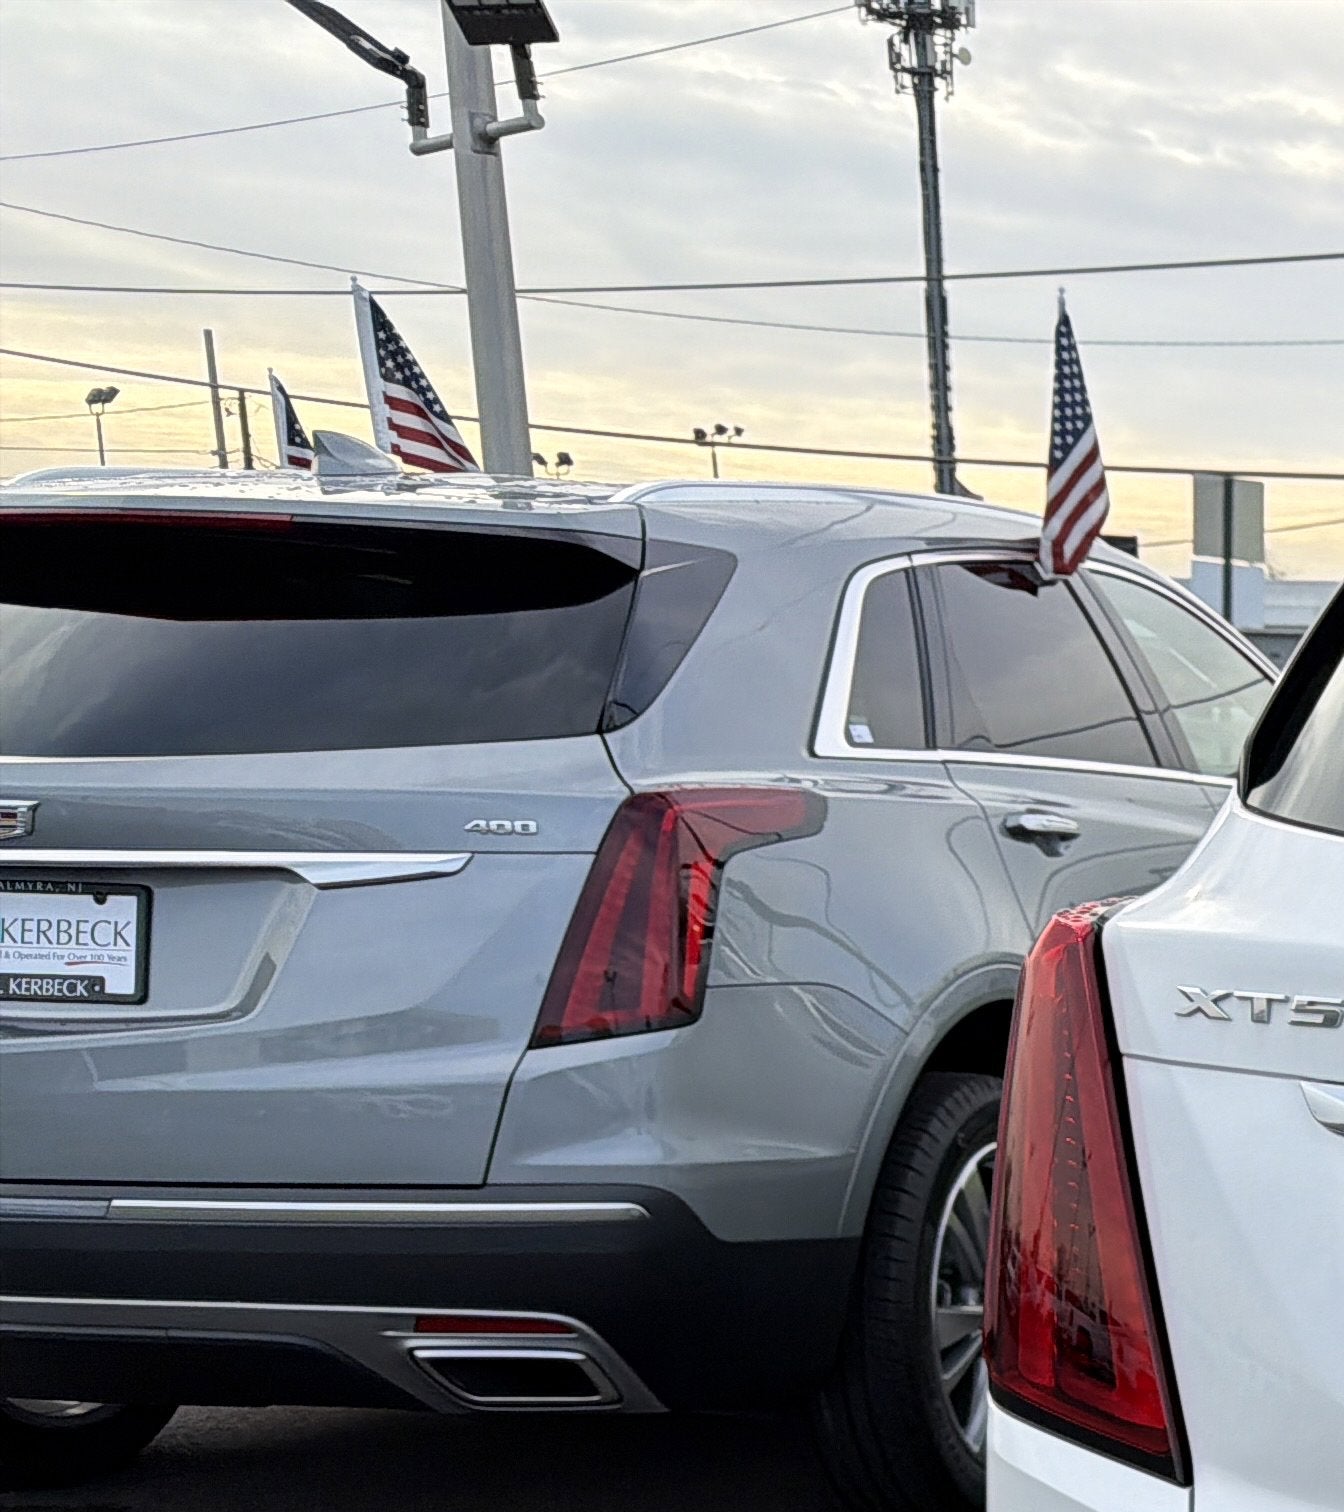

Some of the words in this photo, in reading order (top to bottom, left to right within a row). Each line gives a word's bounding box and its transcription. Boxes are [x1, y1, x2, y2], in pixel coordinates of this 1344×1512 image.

[463, 818, 539, 836] 400
[0, 917, 132, 948] KERBECK
[12, 950, 51, 963] Operated
[52, 953, 66, 961] For
[67, 952, 88, 962] Over
[90, 953, 105, 962] 100
[106, 953, 128, 963] Years
[9, 978, 89, 998] KERBECK
